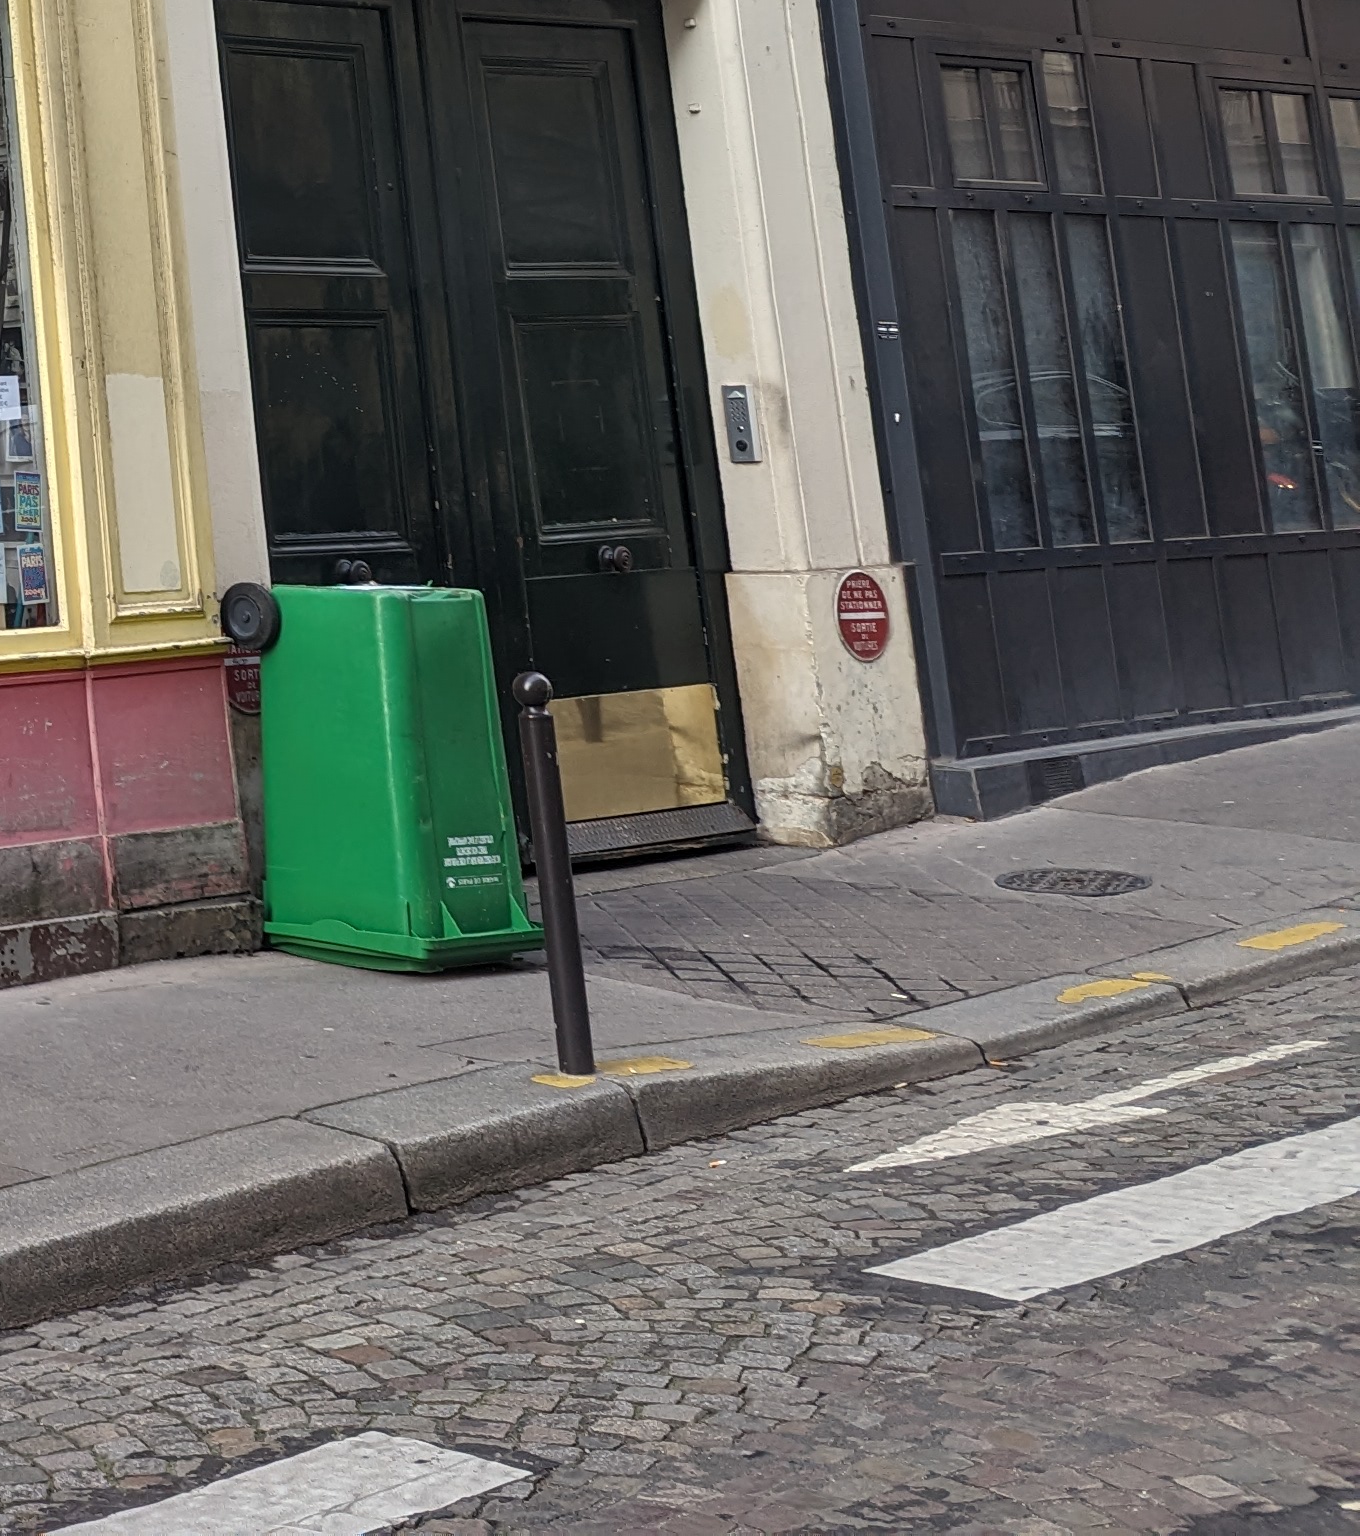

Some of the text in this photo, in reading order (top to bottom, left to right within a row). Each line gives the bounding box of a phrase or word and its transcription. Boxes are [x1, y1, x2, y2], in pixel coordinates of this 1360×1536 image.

[841, 589, 878, 599] DE NE PAS
[840, 600, 882, 610] STATIONNER
[850, 622, 877, 633] SORTIE
[233, 668, 260, 682] SORT
